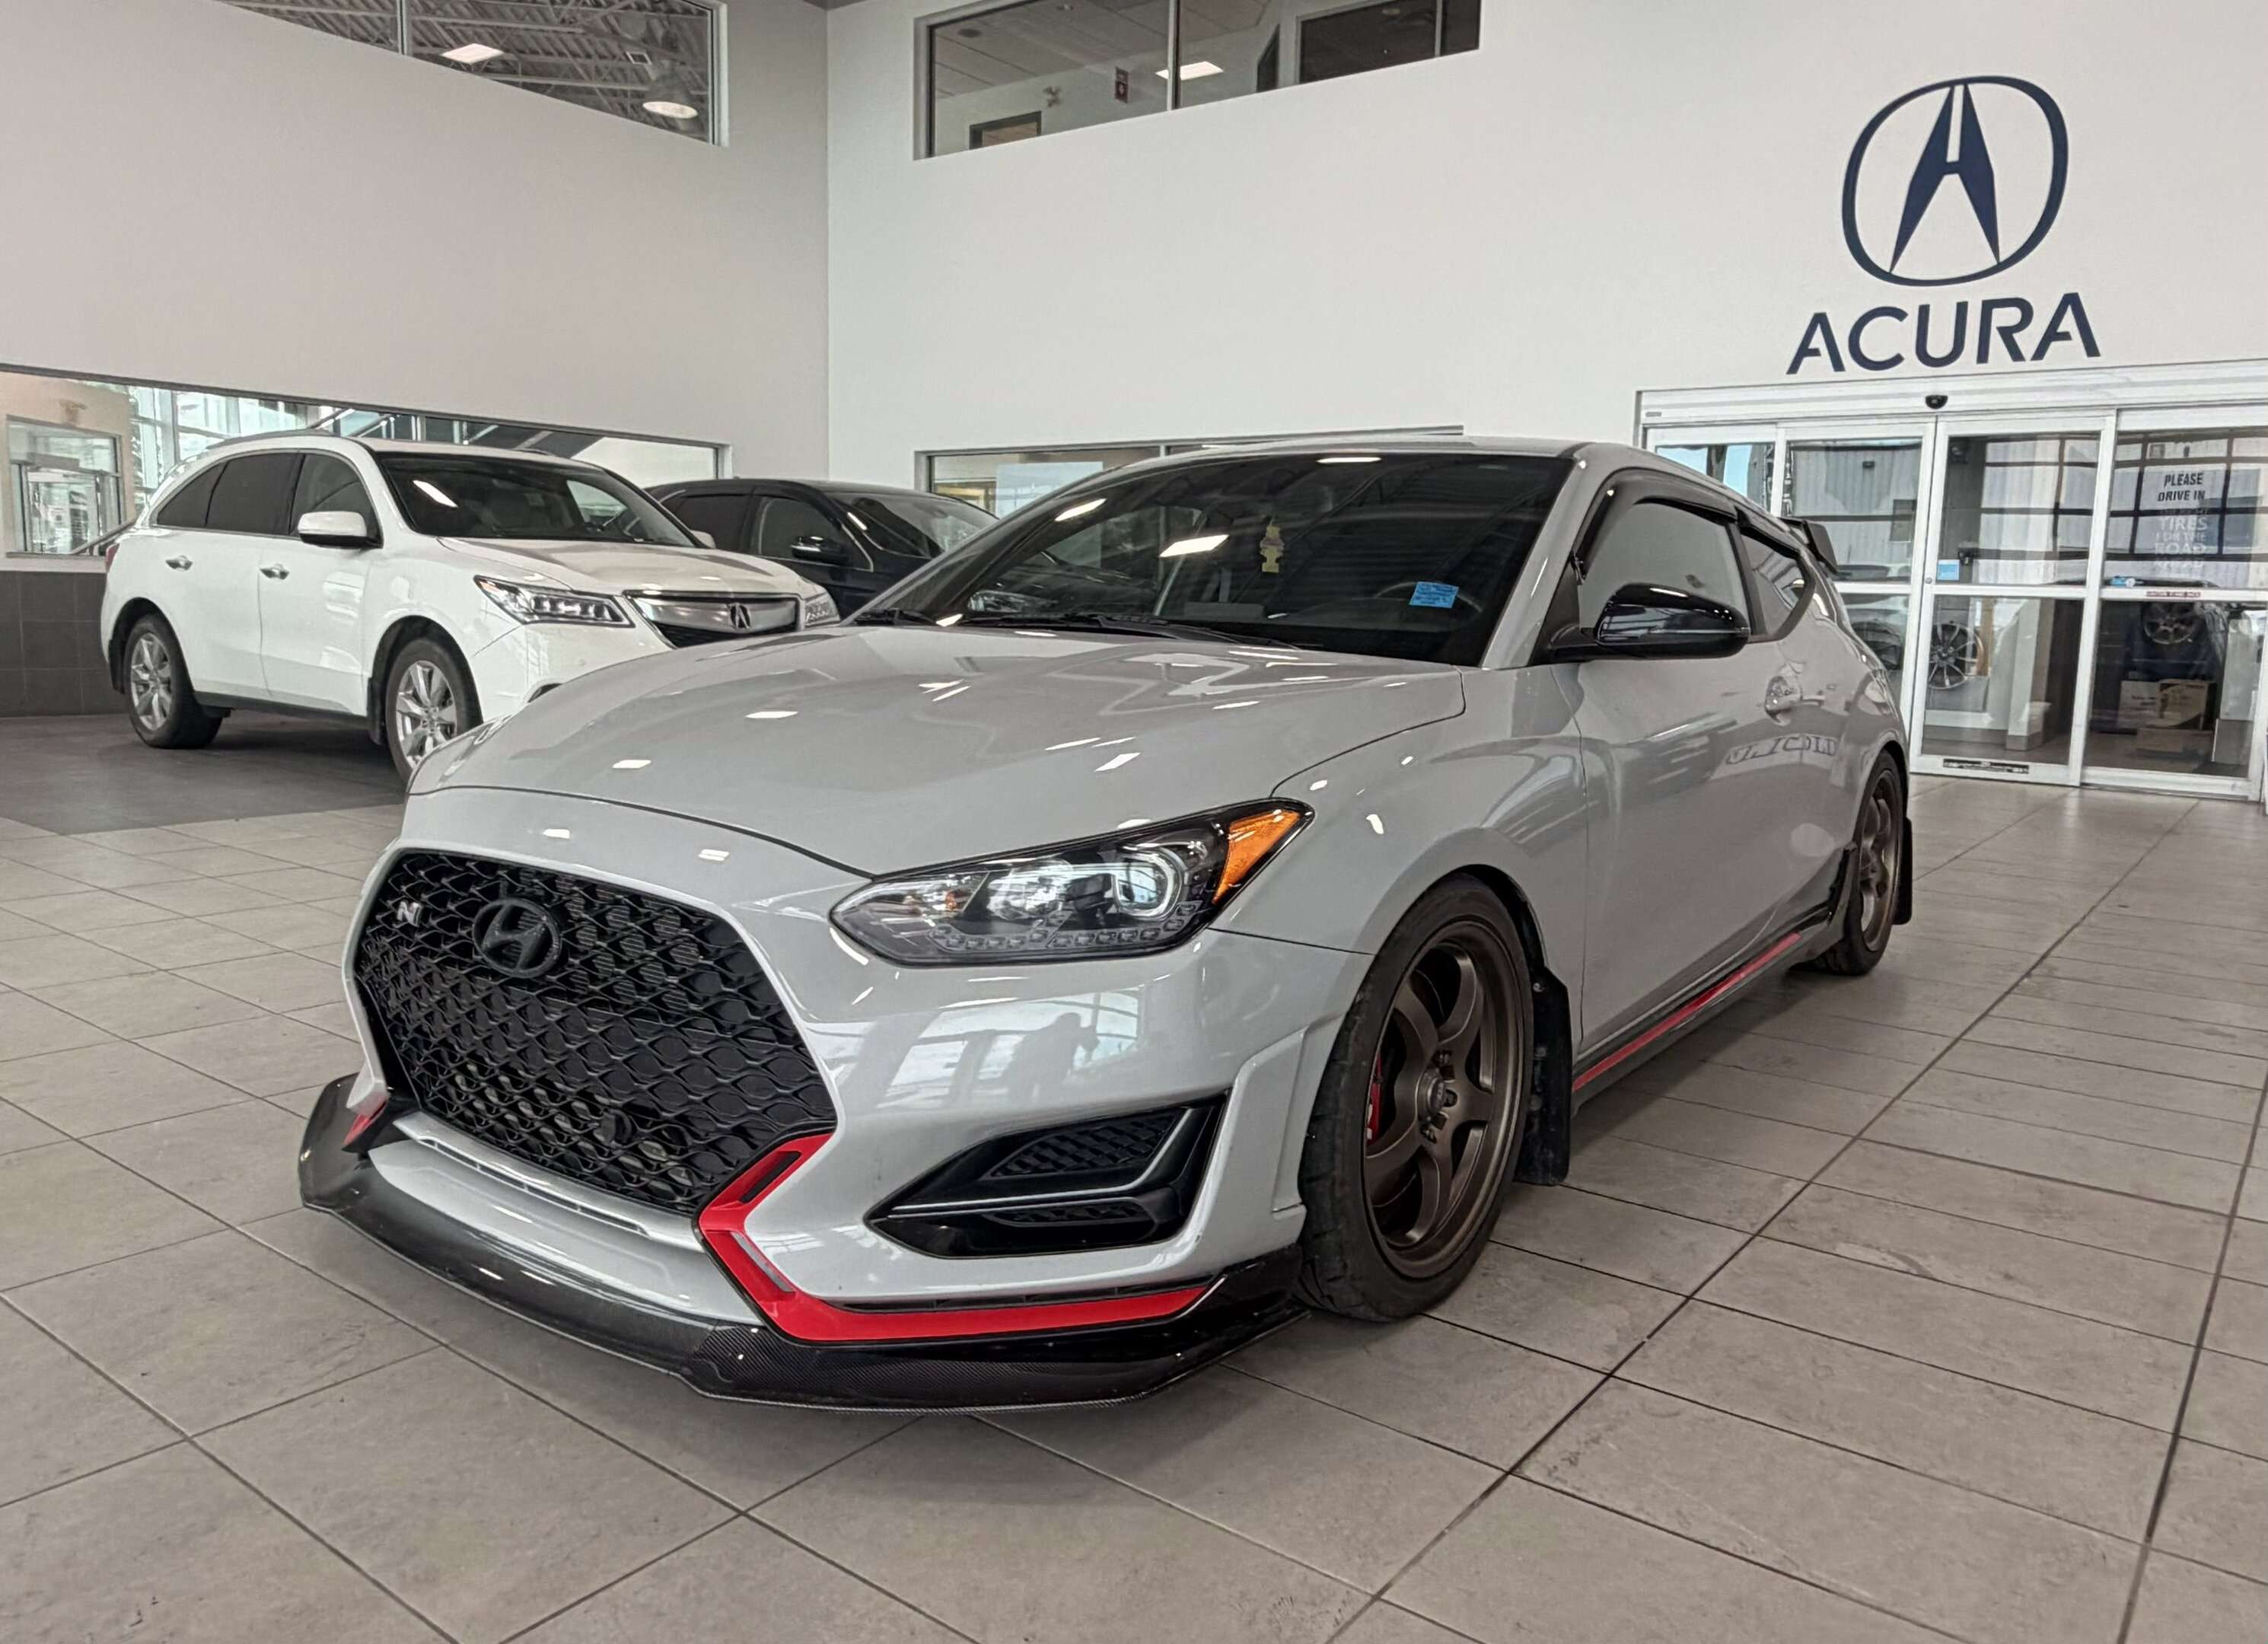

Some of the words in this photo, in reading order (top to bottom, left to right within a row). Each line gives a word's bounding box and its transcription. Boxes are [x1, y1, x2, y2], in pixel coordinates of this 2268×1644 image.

[1785, 292, 2101, 375] ACURA
[2163, 472, 2204, 488] PLEASE
[2157, 490, 2190, 502] DRIVE
[2193, 489, 2206, 501] IN
[397, 900, 423, 928] N
